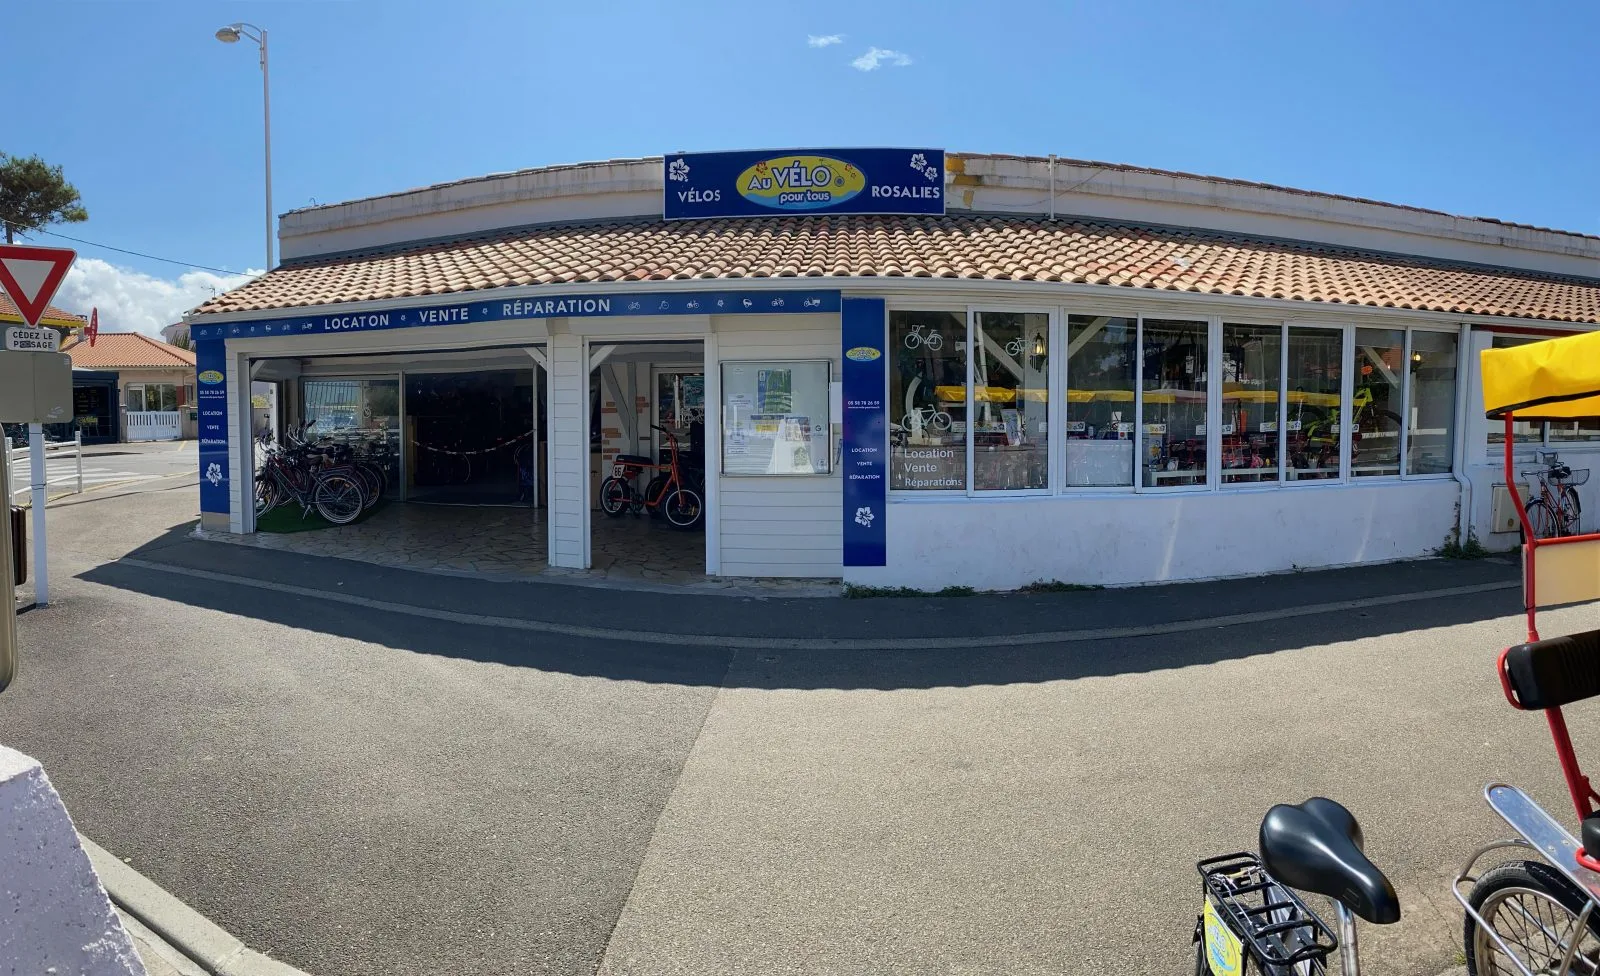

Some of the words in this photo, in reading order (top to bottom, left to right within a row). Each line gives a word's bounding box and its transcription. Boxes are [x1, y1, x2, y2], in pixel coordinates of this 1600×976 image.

[748, 175, 771, 189] Au
[772, 161, 831, 187] VÉLO
[678, 188, 721, 203] VÉLOS
[780, 193, 804, 204] pour
[806, 190, 830, 201] tous
[871, 185, 940, 199] ROSALIES
[503, 299, 611, 316] RÉPARATION
[324, 314, 389, 330] LOCATON
[419, 307, 469, 323] VENTE
[12, 330, 40, 339] CÉDEZ
[43, 332, 54, 340] LE
[13, 340, 53, 349] PSAGE
[904, 448, 954, 459] Location
[904, 462, 937, 473] Vente
[904, 477, 962, 488] Réparations
